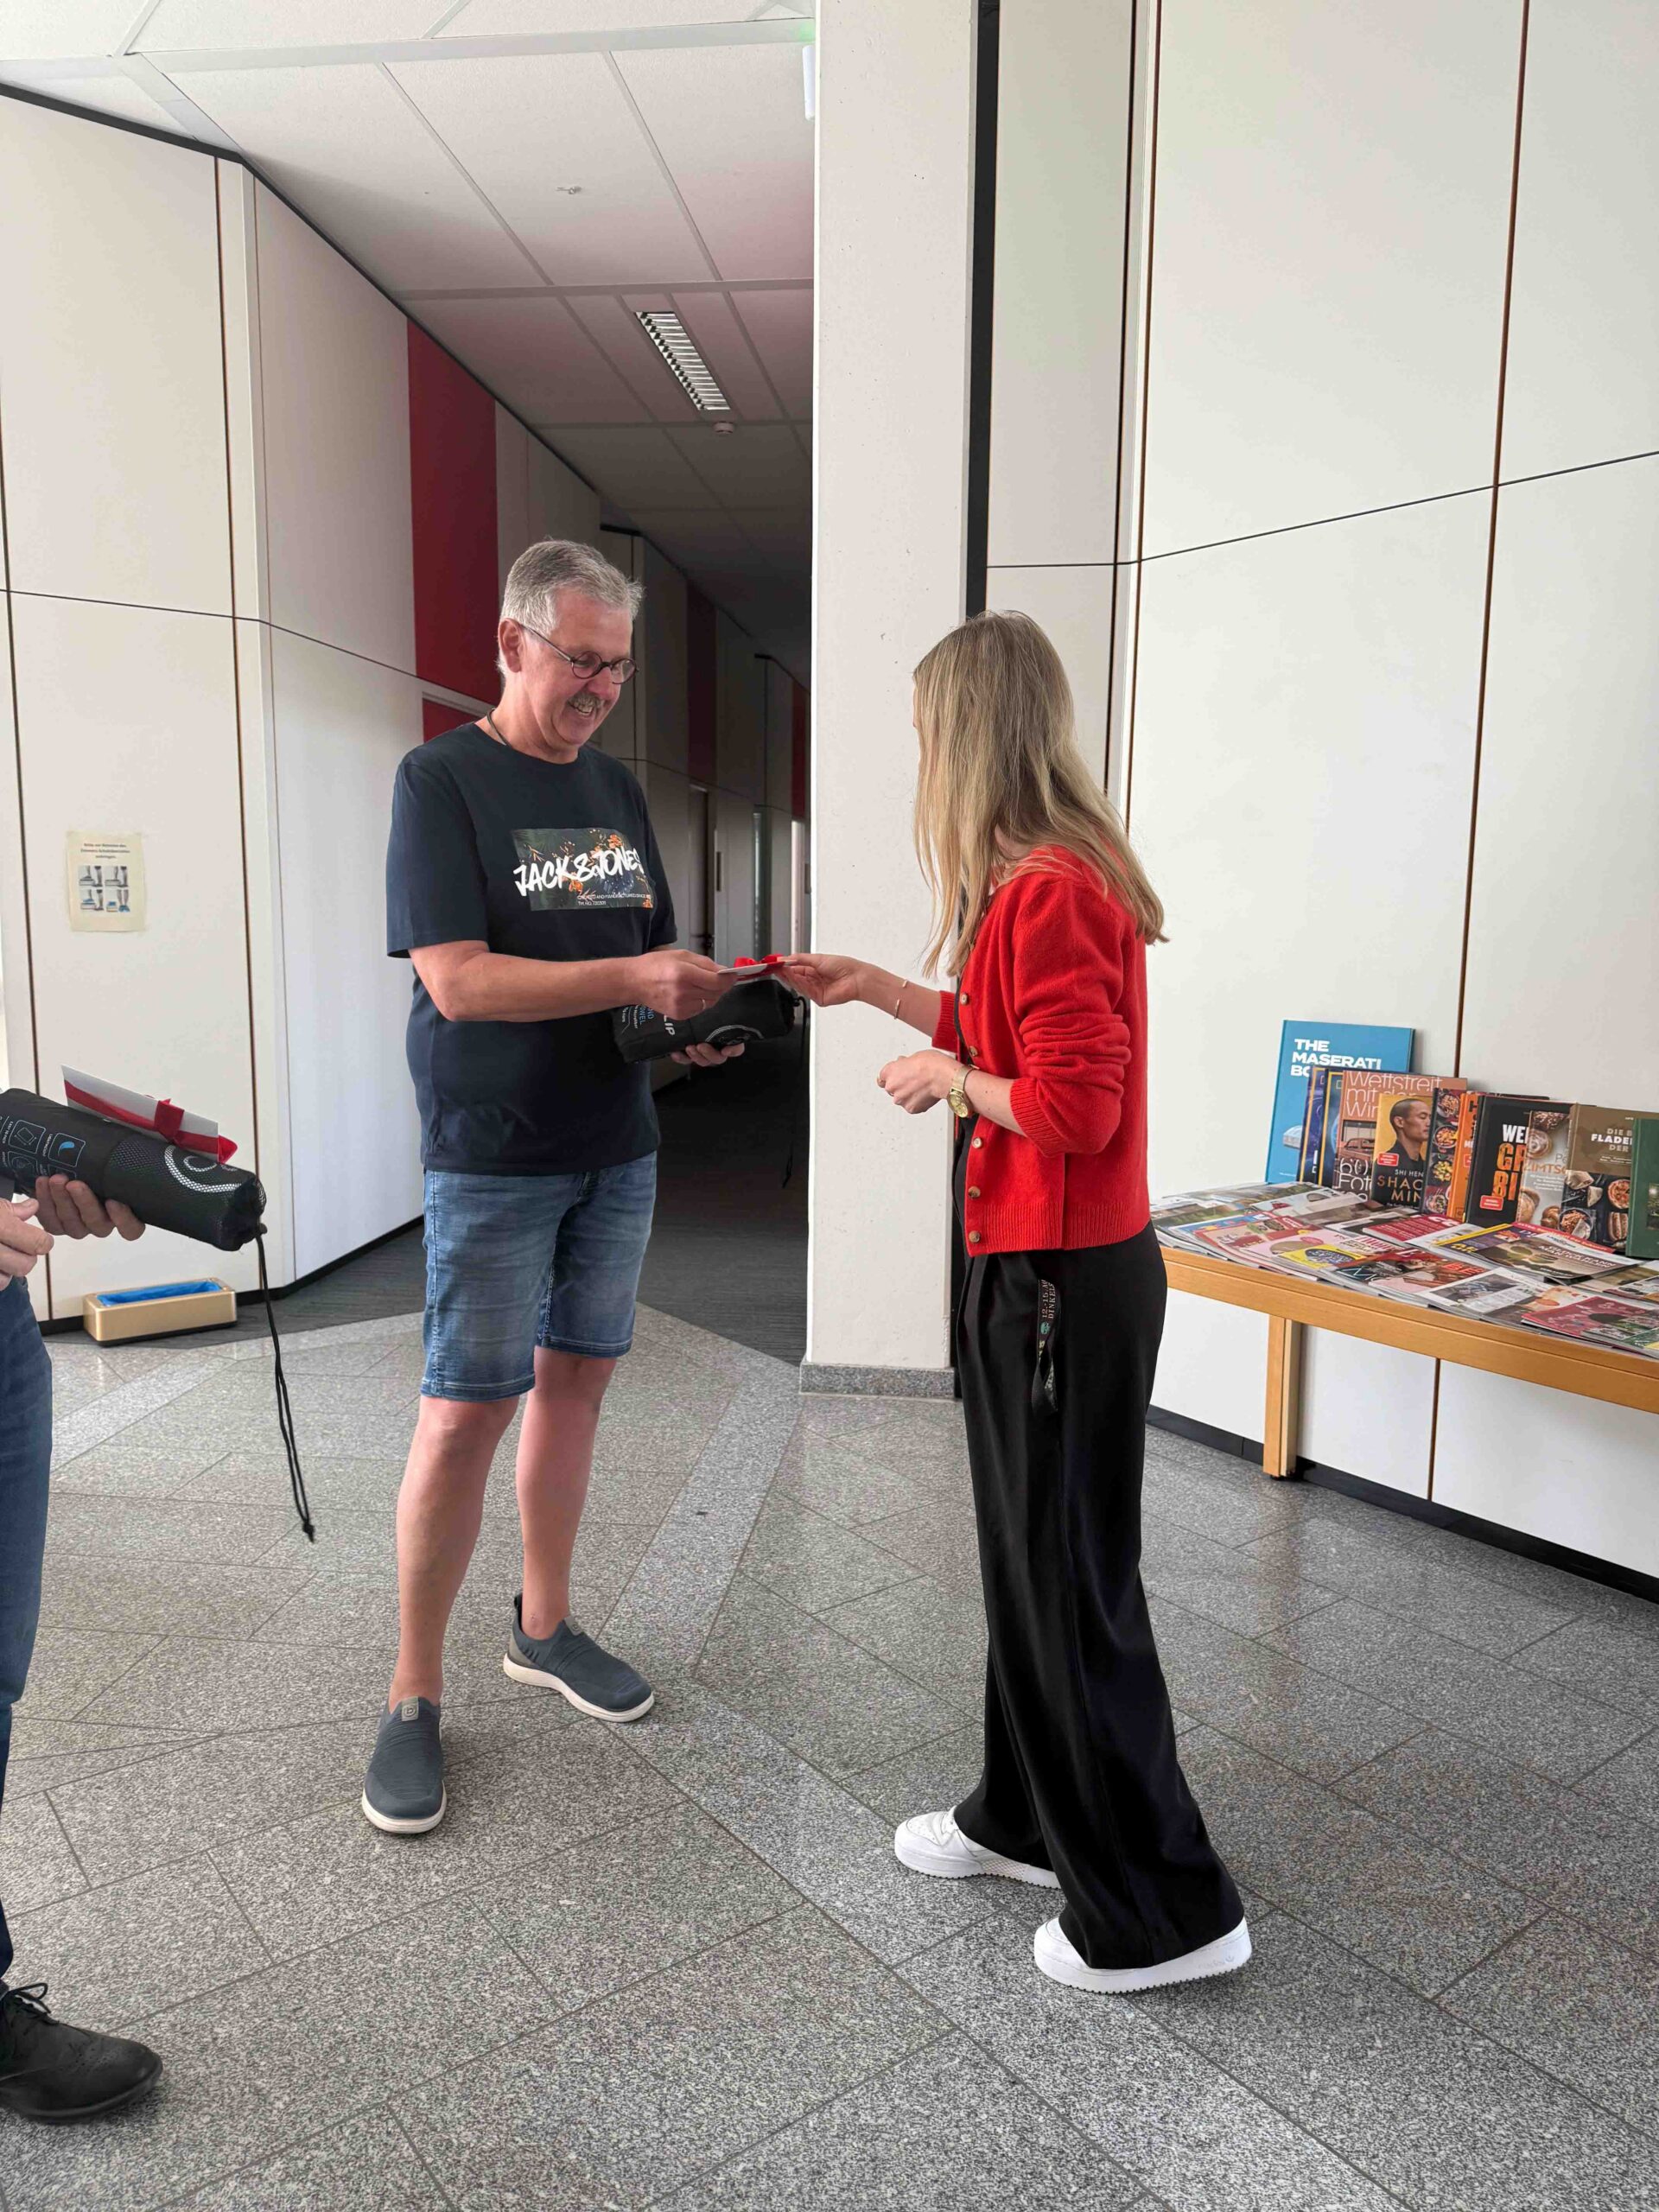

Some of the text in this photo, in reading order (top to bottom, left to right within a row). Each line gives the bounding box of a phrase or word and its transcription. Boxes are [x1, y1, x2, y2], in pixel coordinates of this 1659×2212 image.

[1294, 1039, 1330, 1052] THE
[1292, 1052, 1382, 1070] MASERATI
[1348, 1071, 1443, 1092] Wettstreit
[1346, 1088, 1378, 1103] mit
[1607, 1128, 1623, 1136] DIE
